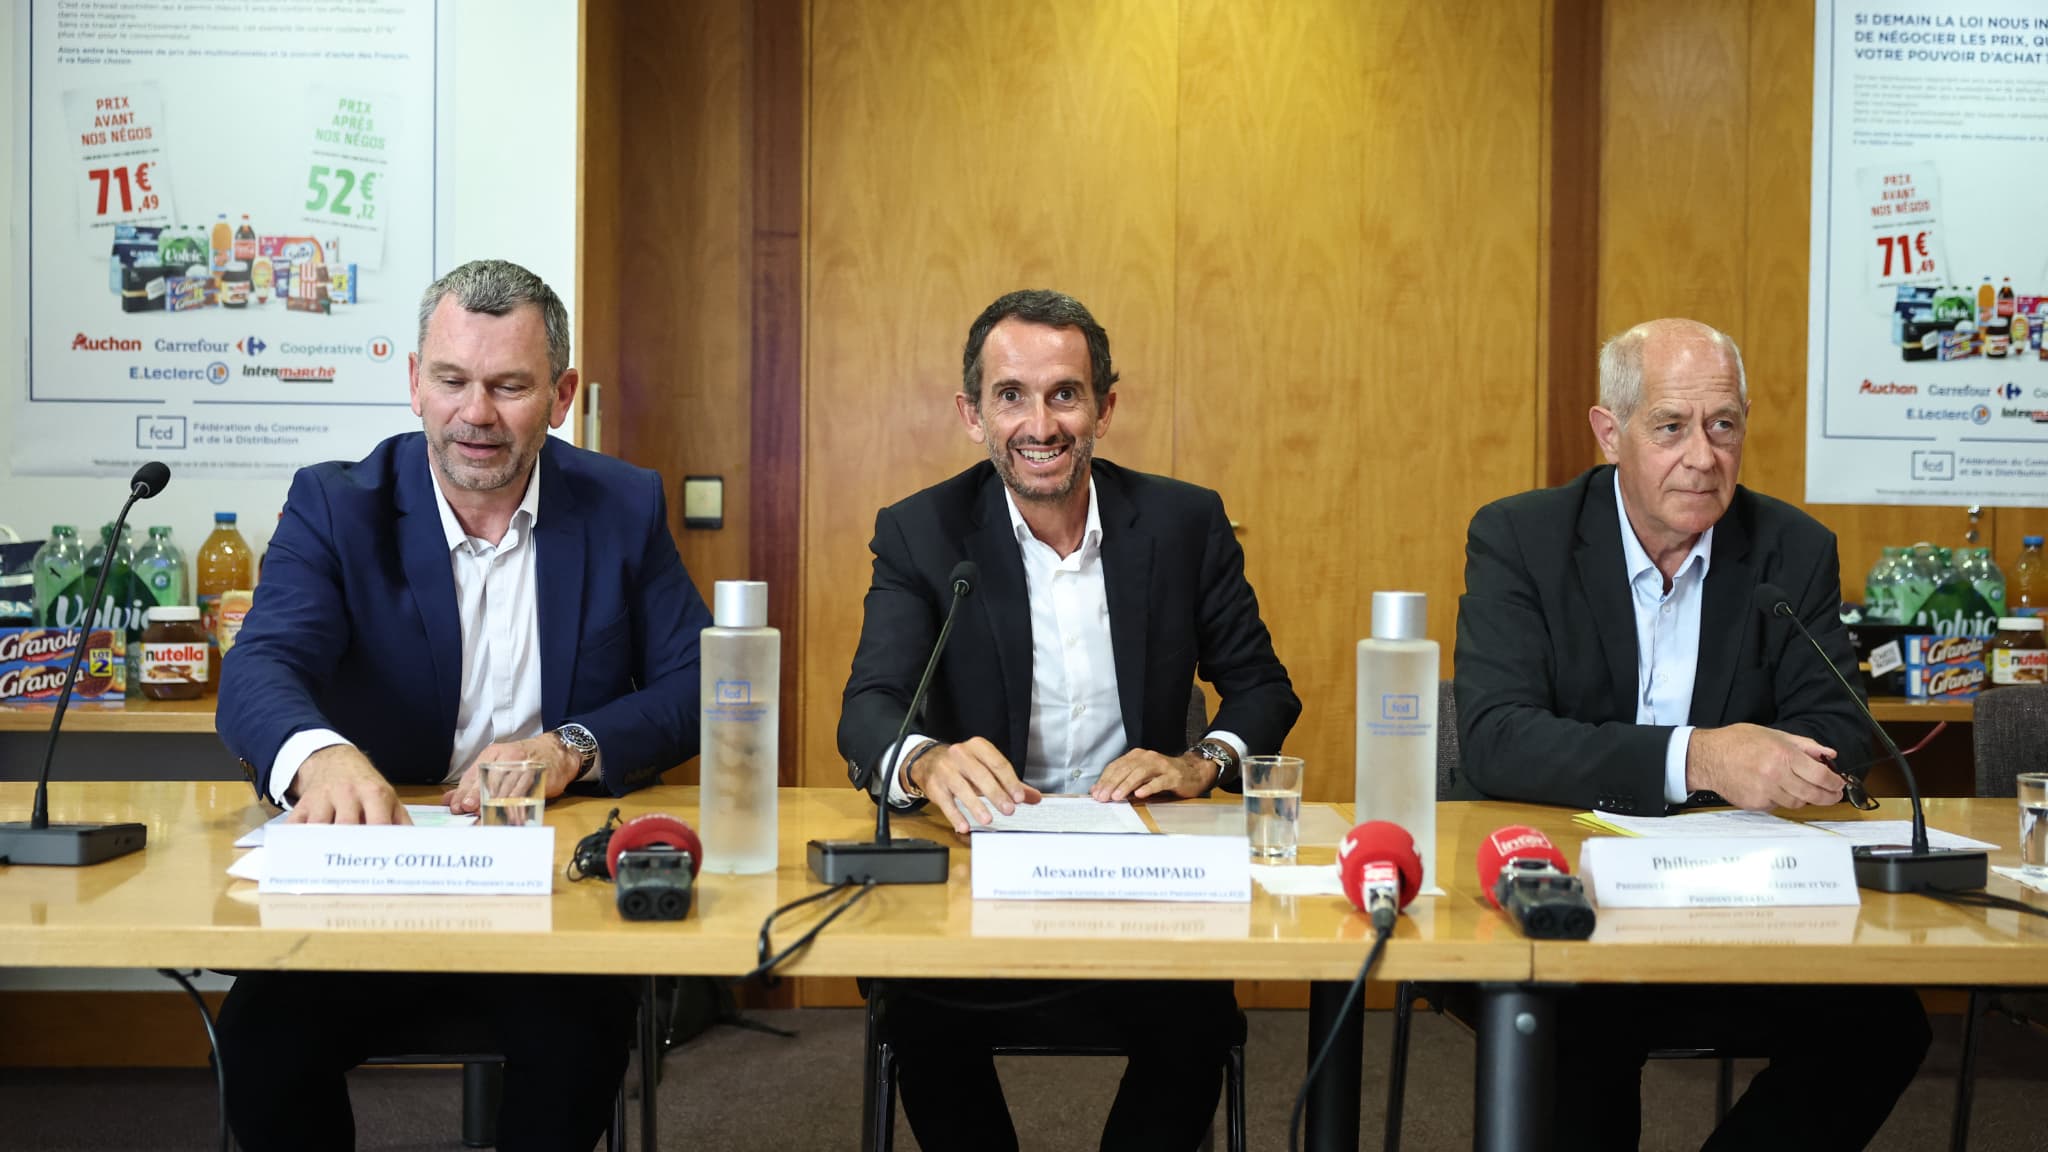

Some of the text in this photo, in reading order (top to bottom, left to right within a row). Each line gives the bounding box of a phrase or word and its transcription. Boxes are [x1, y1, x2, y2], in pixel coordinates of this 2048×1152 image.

[1855, 14, 1868, 25] SI
[1872, 14, 1931, 26] DEMAIN
[1936, 15, 1955, 27] LA
[1960, 16, 1983, 28] LOI
[1988, 17, 2029, 29] NOUS
[1855, 31, 1873, 42] DE
[1961, 34, 1986, 45] LES
[1855, 49, 1903, 60] VOTRE
[1908, 50, 1976, 62] POUVOIR
[96, 96, 129, 110] PRIX
[338, 98, 372, 114] PRIX
[95, 112, 134, 128] AVANT
[81, 131, 106, 146] NOS
[73, 332, 142, 352] Auchan
[154, 338, 230, 353] Carrefour
[1859, 379, 1917, 395] Auchan
[1928, 384, 1992, 397] Carrefour
[150, 425, 173, 440] fcd
[193, 422, 329, 433] Fédération du Commerce
[193, 435, 299, 445] et de la Distribution
[1922, 459, 1944, 473] fcd
[145, 645, 204, 662] nutella
[95, 659, 109, 673] 2
[0, 667, 84, 698] Granoa
[324, 853, 494, 869] Thierry COTILLARD
[1032, 865, 1206, 880] Alexandre BOMPARD
